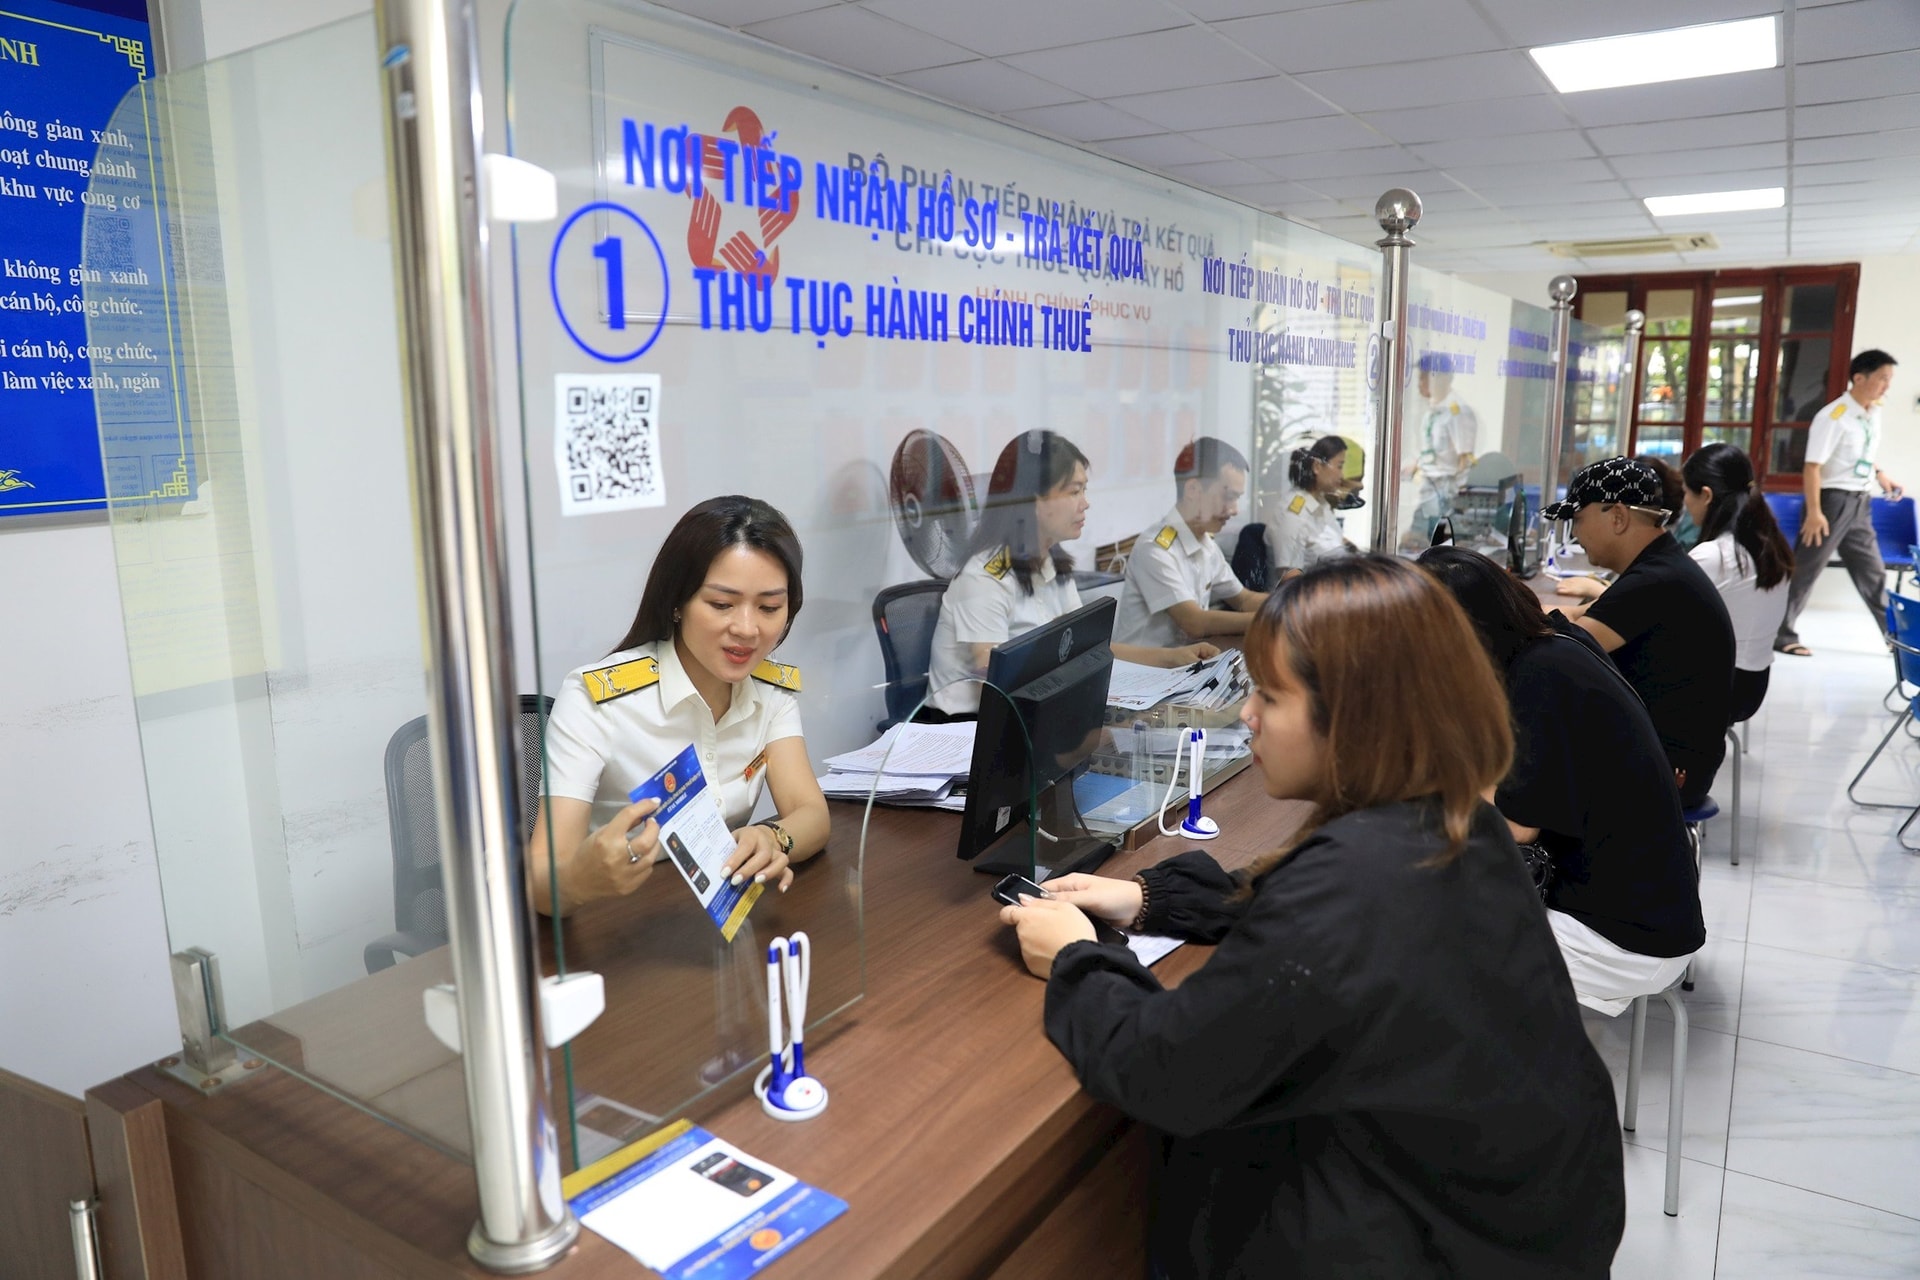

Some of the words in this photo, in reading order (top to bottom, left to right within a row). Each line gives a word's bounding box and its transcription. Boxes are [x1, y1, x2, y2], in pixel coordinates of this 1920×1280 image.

[46, 119, 83, 141] gian
[0, 176, 37, 198] khu
[43, 186, 73, 206] vực
[123, 195, 140, 210] cơ
[622, 118, 704, 199] NƠI
[717, 131, 803, 214] TIẾP
[816, 162, 908, 241] NHẬN
[918, 174, 955, 242] HỒ
[964, 197, 998, 250] SƠ
[1021, 203, 1062, 263] TRẢ
[1068, 212, 1103, 271] KẾT
[1109, 225, 1144, 280] QUẢ
[981, 182, 1029, 221] TIẾP
[1098, 210, 1118, 238] VÀ
[1156, 223, 1184, 254] KẾT
[1187, 233, 1214, 260] QUẢ
[3, 258, 61, 285] không
[110, 268, 149, 285] xanh
[592, 236, 625, 330] 1
[1164, 263, 1184, 292] HỒ
[1203, 257, 1225, 295] NƠI
[1229, 252, 1254, 299] TIẾP
[1257, 267, 1287, 314] NHẬN
[1290, 268, 1303, 308] HỒ
[1306, 280, 1318, 311] SƠ
[1344, 281, 1359, 319] KẾT
[0, 291, 31, 311] cán
[32, 293, 61, 316] bộ,
[101, 296, 143, 315] chức.
[692, 250, 773, 333] THỦ
[785, 277, 854, 349] TỤC
[865, 276, 948, 342] HÀNH
[958, 289, 1033, 347] CHÍNH
[1041, 294, 1092, 352] THUẾ
[11, 339, 43, 358] cán
[46, 340, 74, 363] bộ,
[116, 342, 157, 363] chức,
[1229, 317, 1251, 363] THỦ
[1370, 344, 1380, 379] 2
[2, 371, 37, 389] làm
[40, 371, 74, 394] việc
[122, 373, 160, 393] ngăn
